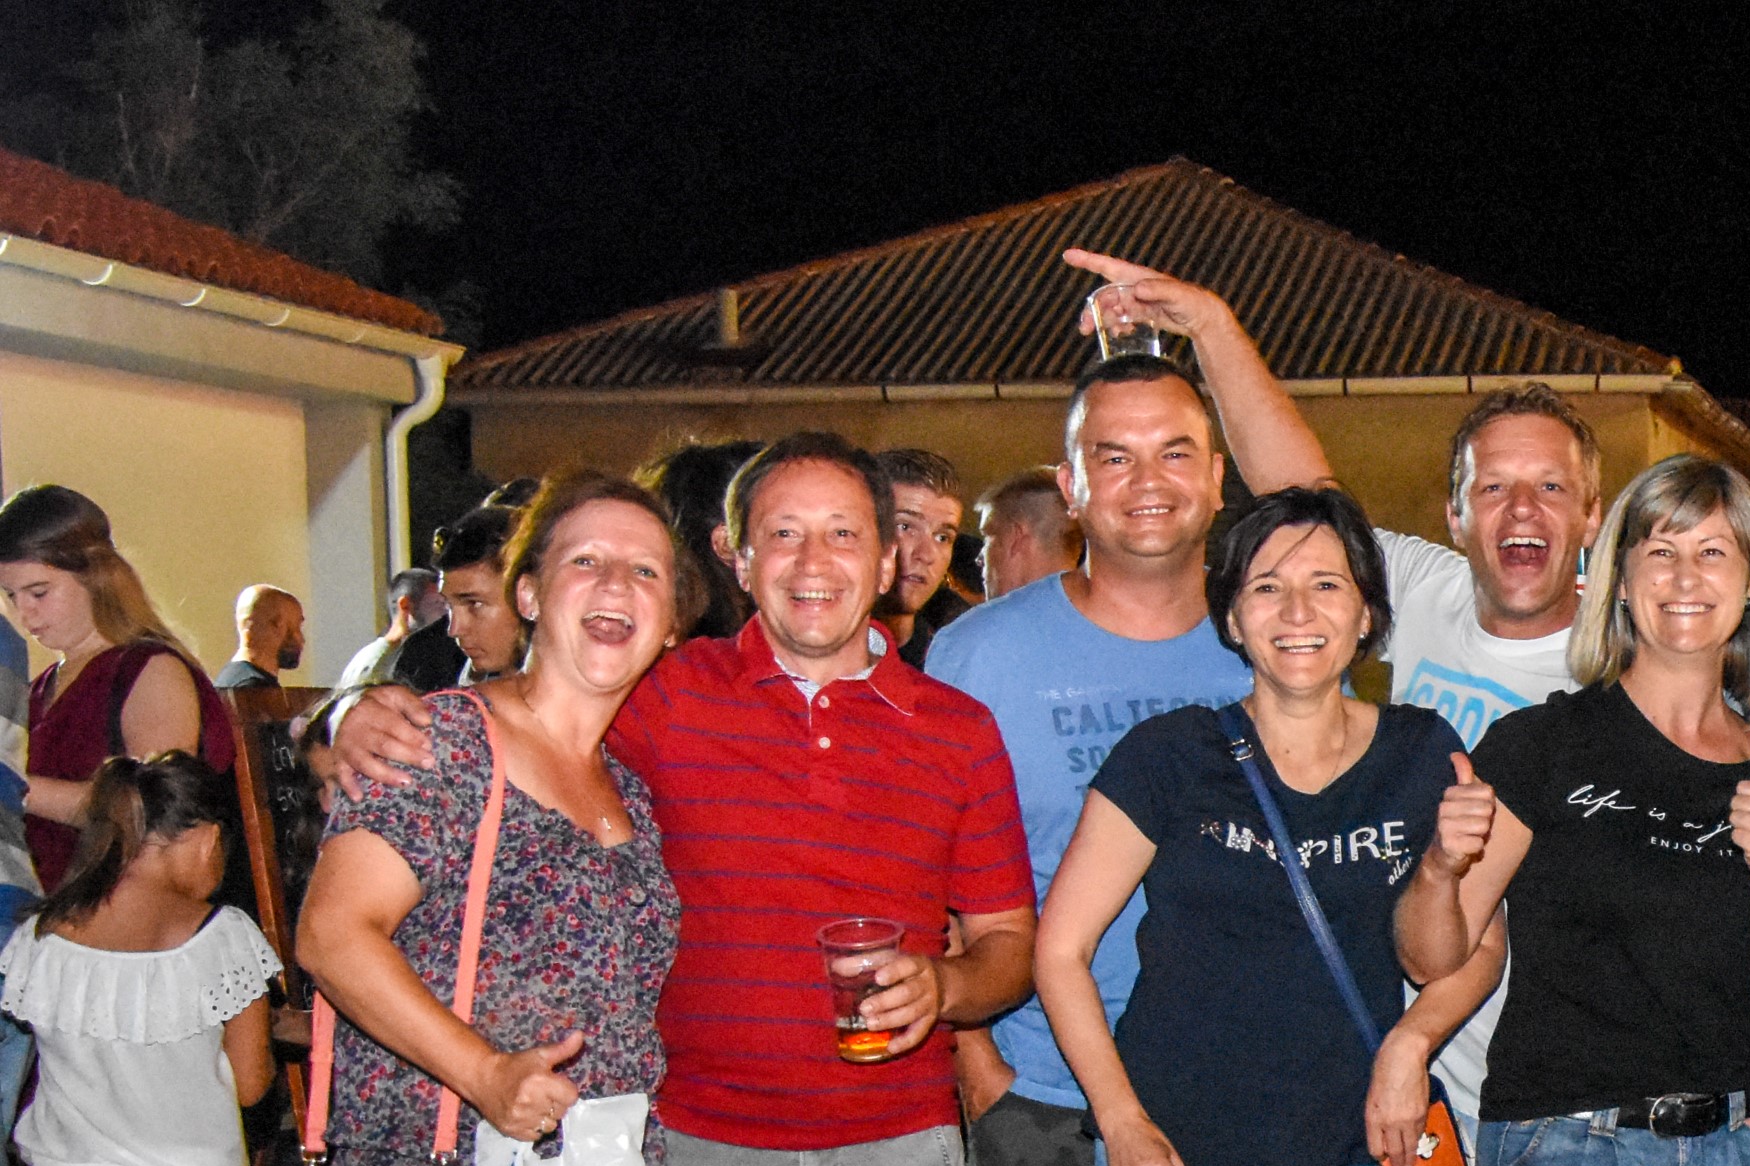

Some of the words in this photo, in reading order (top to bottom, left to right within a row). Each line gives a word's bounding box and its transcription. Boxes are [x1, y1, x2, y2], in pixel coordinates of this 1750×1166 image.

[1568, 784, 1637, 818] life
[1649, 807, 1666, 821] is
[1650, 836, 1702, 853] ENJOY
[1719, 849, 1733, 857] IT
